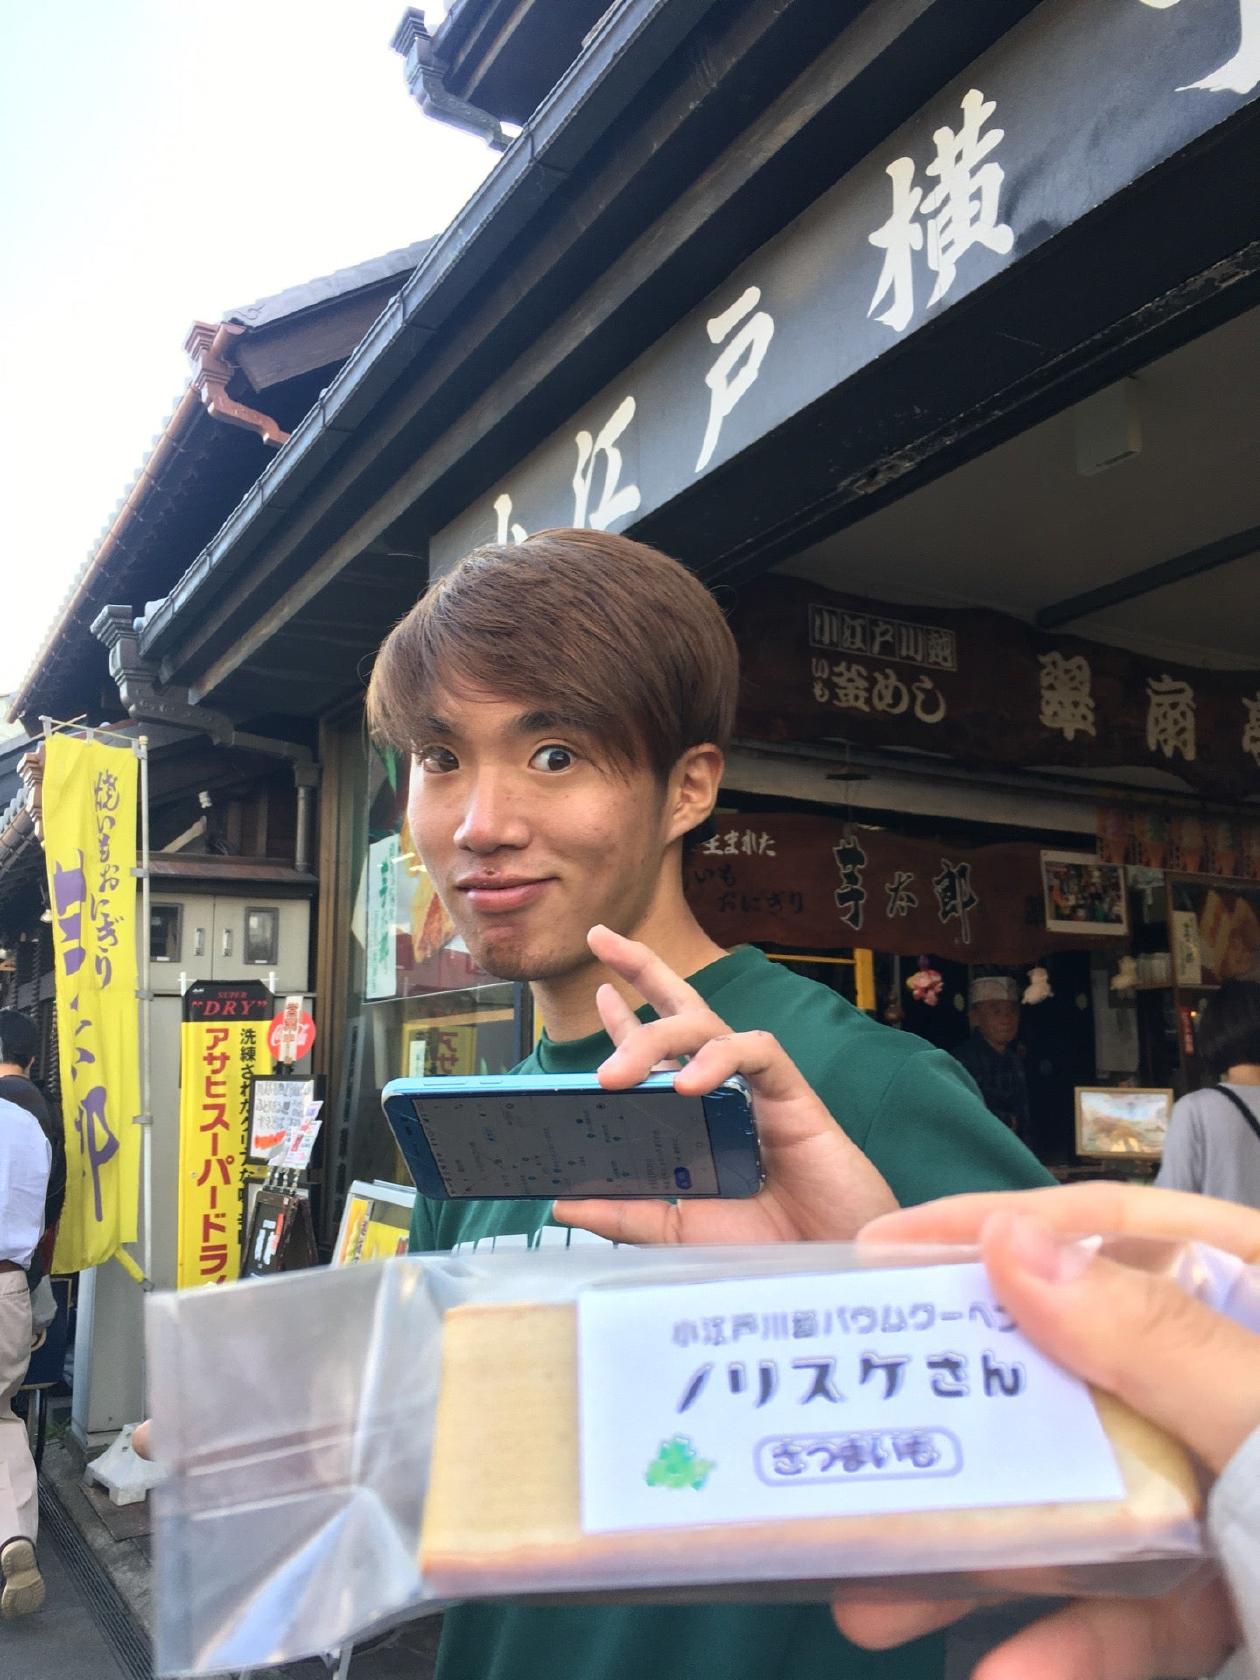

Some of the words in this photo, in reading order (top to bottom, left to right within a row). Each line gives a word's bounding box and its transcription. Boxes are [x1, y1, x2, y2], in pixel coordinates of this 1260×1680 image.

[197, 1027, 236, 1284] アサヒスーパードラ
[676, 1349, 1027, 1414] ノリスケさん
